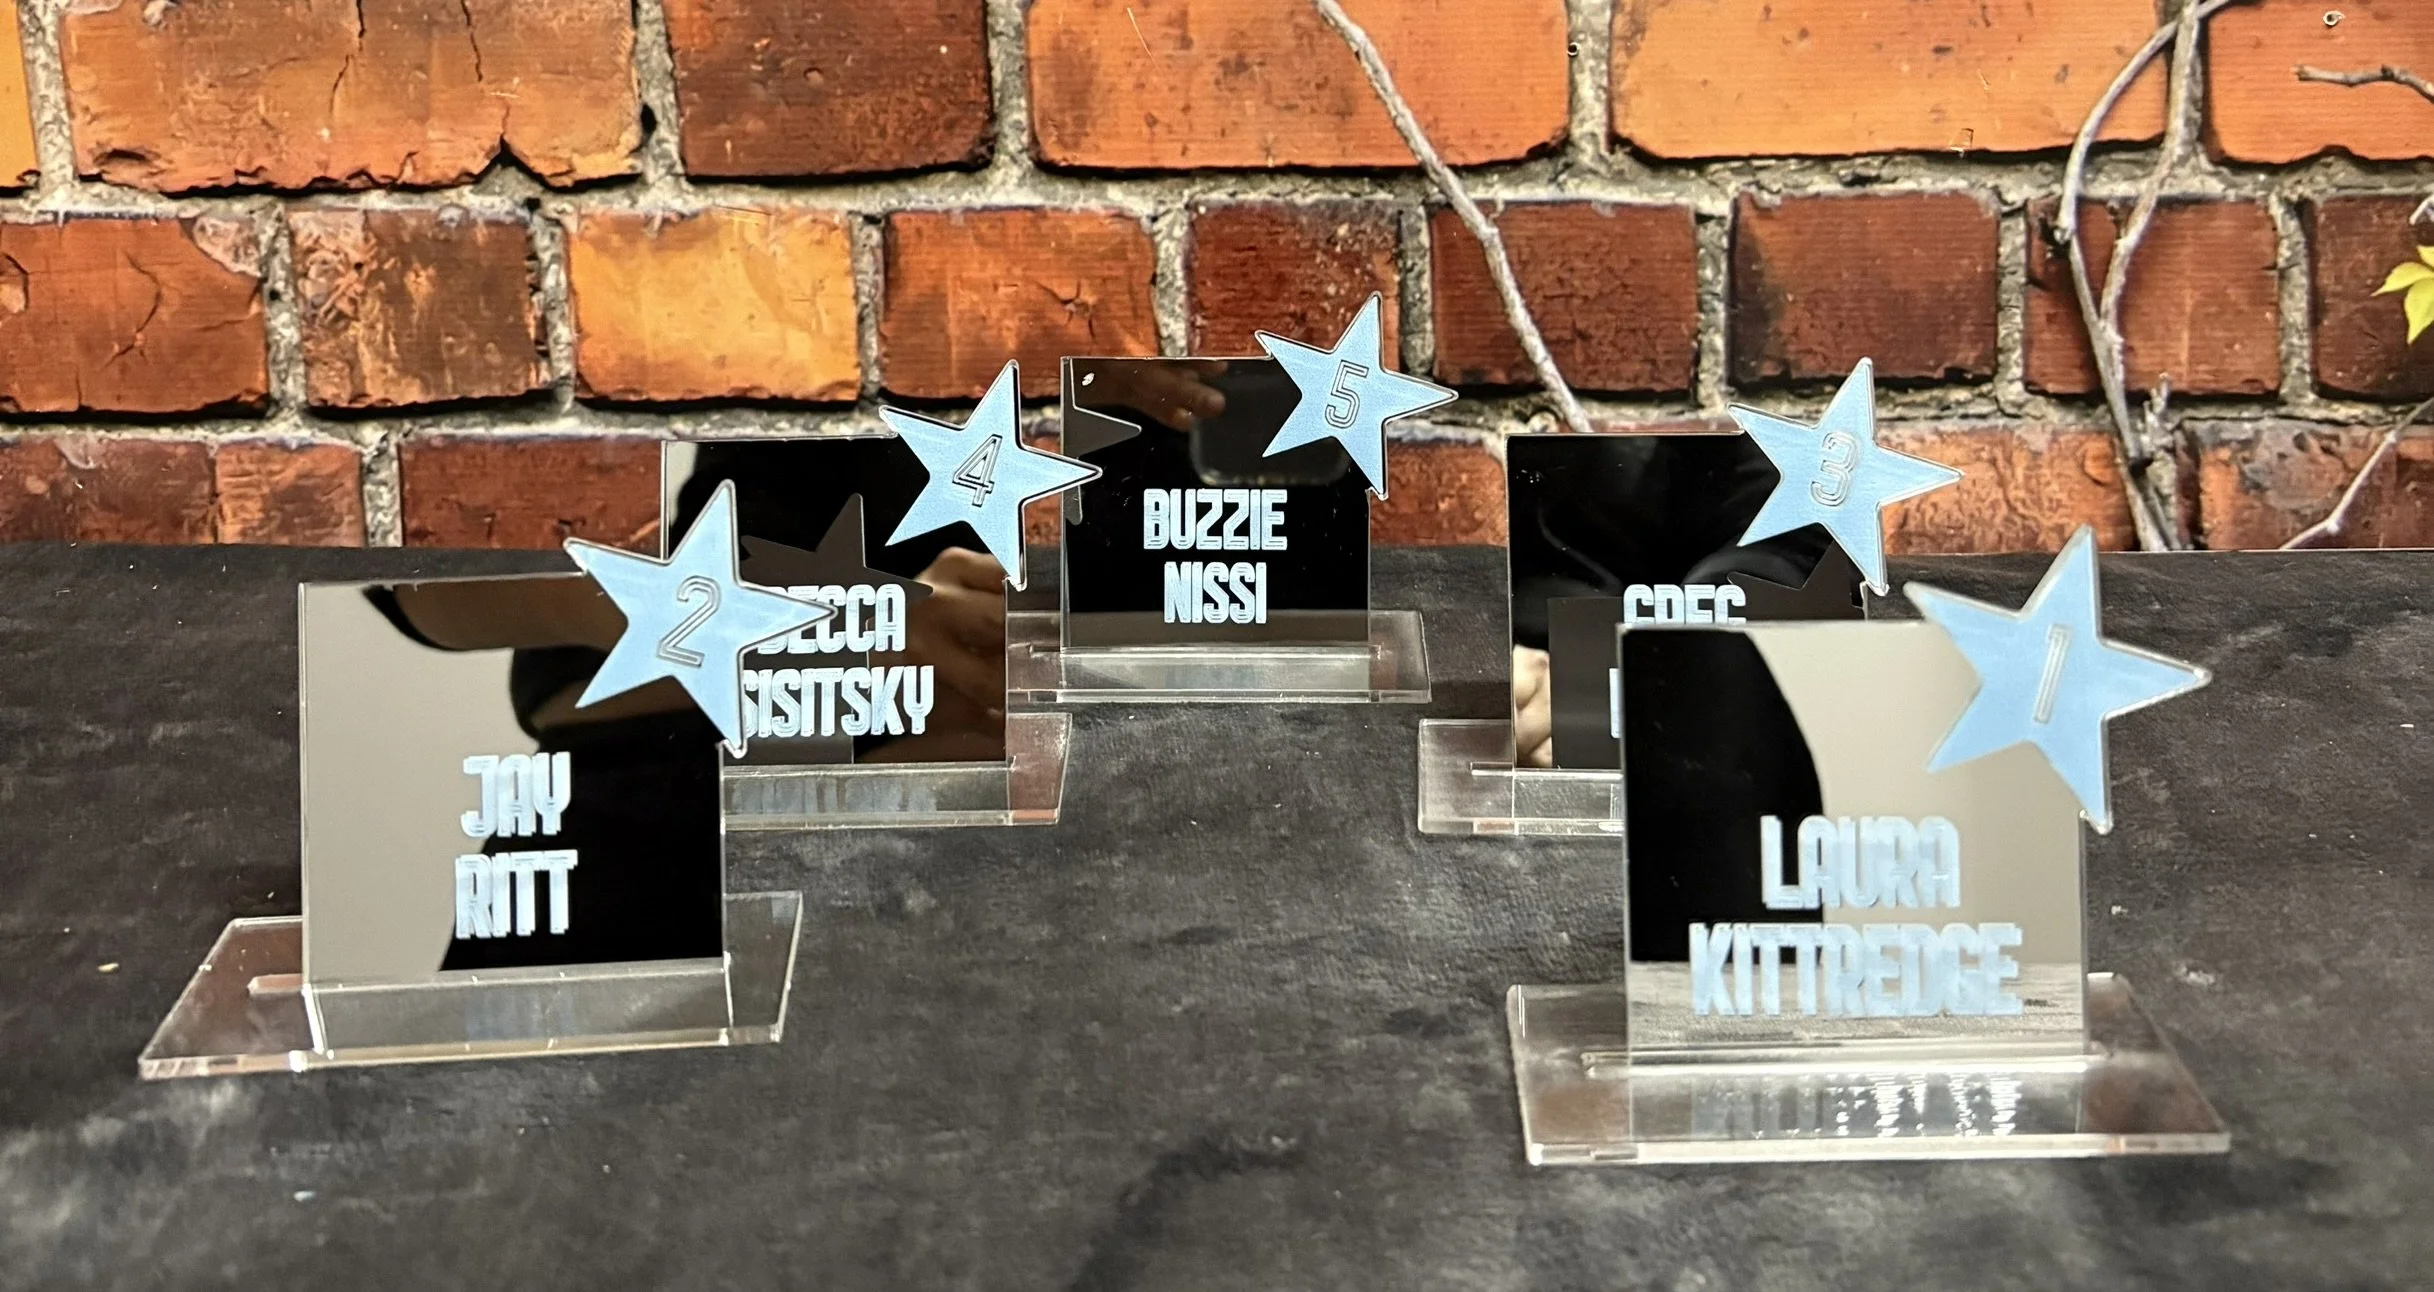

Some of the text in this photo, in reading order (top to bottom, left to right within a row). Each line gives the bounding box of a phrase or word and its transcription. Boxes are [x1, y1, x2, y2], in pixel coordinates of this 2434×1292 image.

[1324, 359, 1370, 429] 5
[952, 433, 1003, 507] 4
[1811, 430, 1863, 508] 3
[1143, 488, 1288, 551] BUZZIE
[656, 574, 722, 668] 2
[1163, 561, 1268, 625] NISSI
[2033, 622, 2073, 725] 1
[459, 751, 572, 838] JAY
[455, 849, 578, 939] RITT
[1760, 814, 1961, 909] LAURA
[1688, 922, 2024, 1017] KITTREDGE
